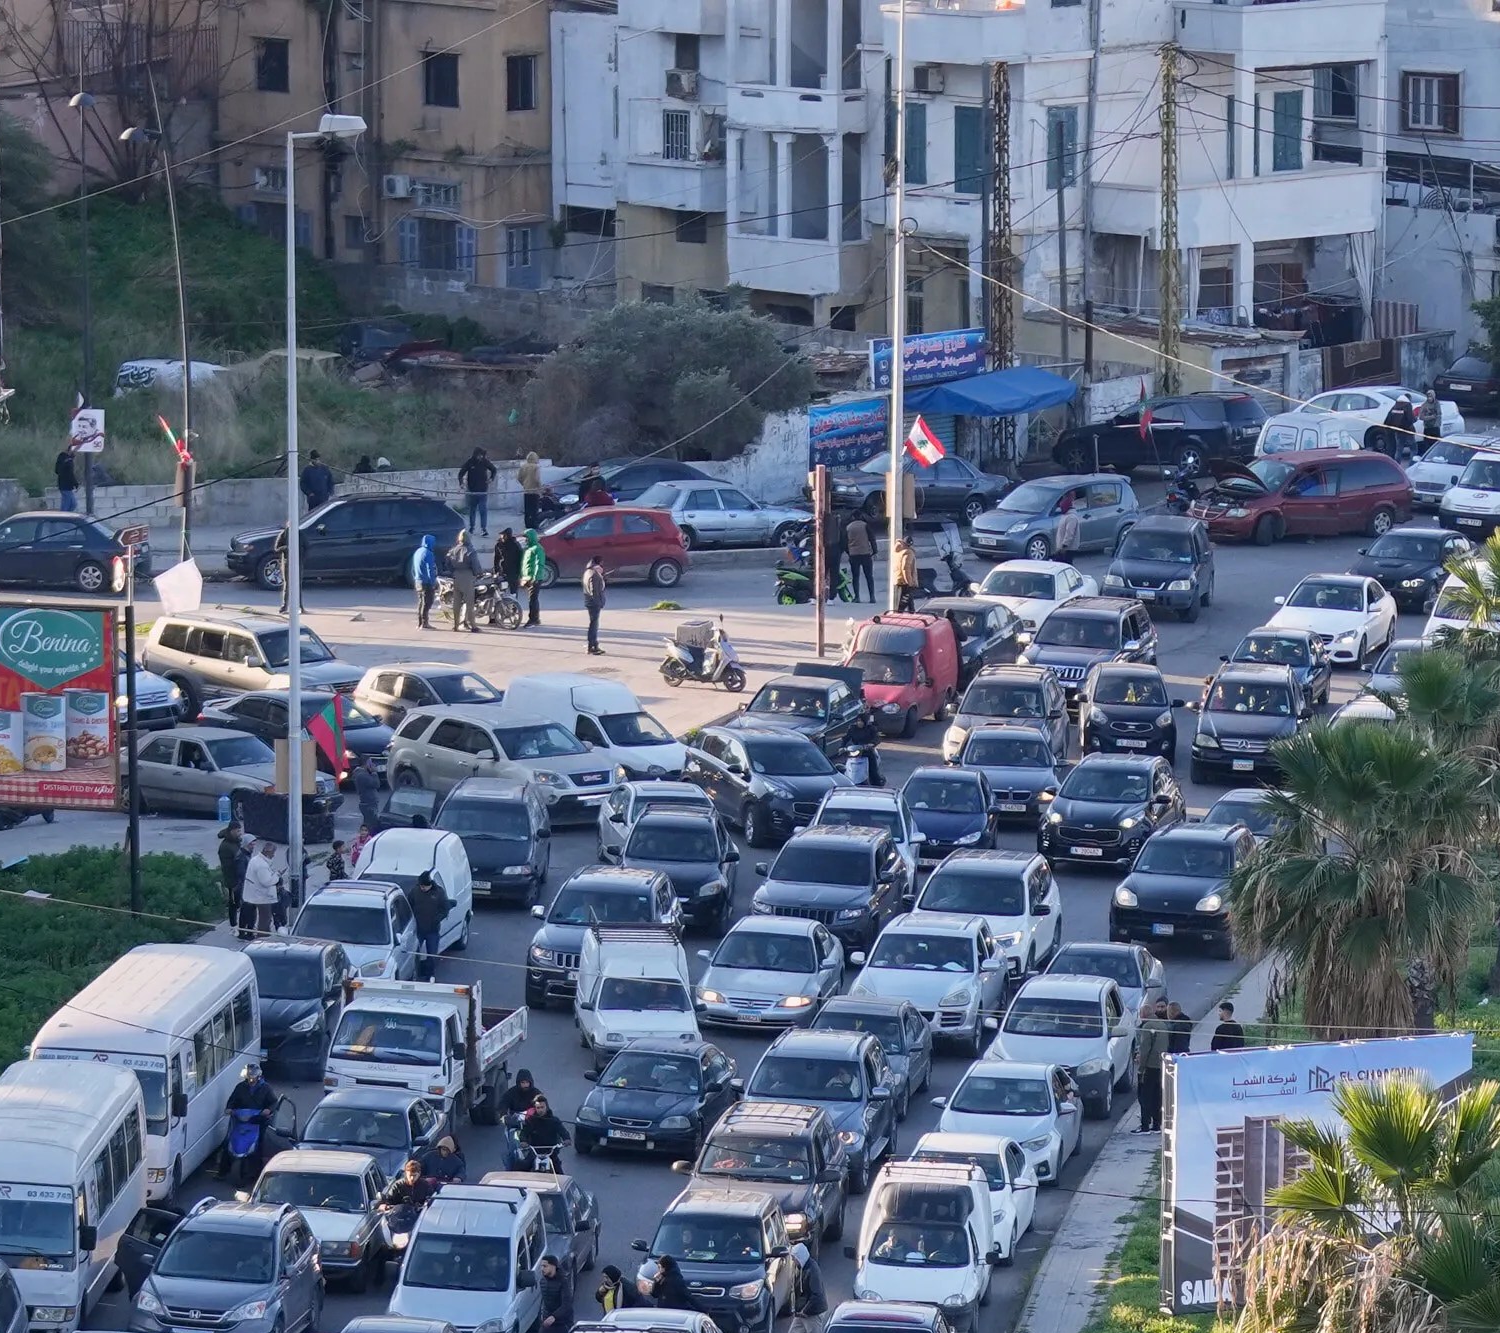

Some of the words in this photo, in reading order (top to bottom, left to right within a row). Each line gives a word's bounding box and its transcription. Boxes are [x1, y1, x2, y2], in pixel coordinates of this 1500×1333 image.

[8, 620, 92, 654] Benina
[43, 784, 84, 792] DISTRIBUTED
[1232, 1073, 1266, 1087] الشما
[1266, 1072, 1298, 1087] شركة
[1230, 1086, 1298, 1100] العقارية
